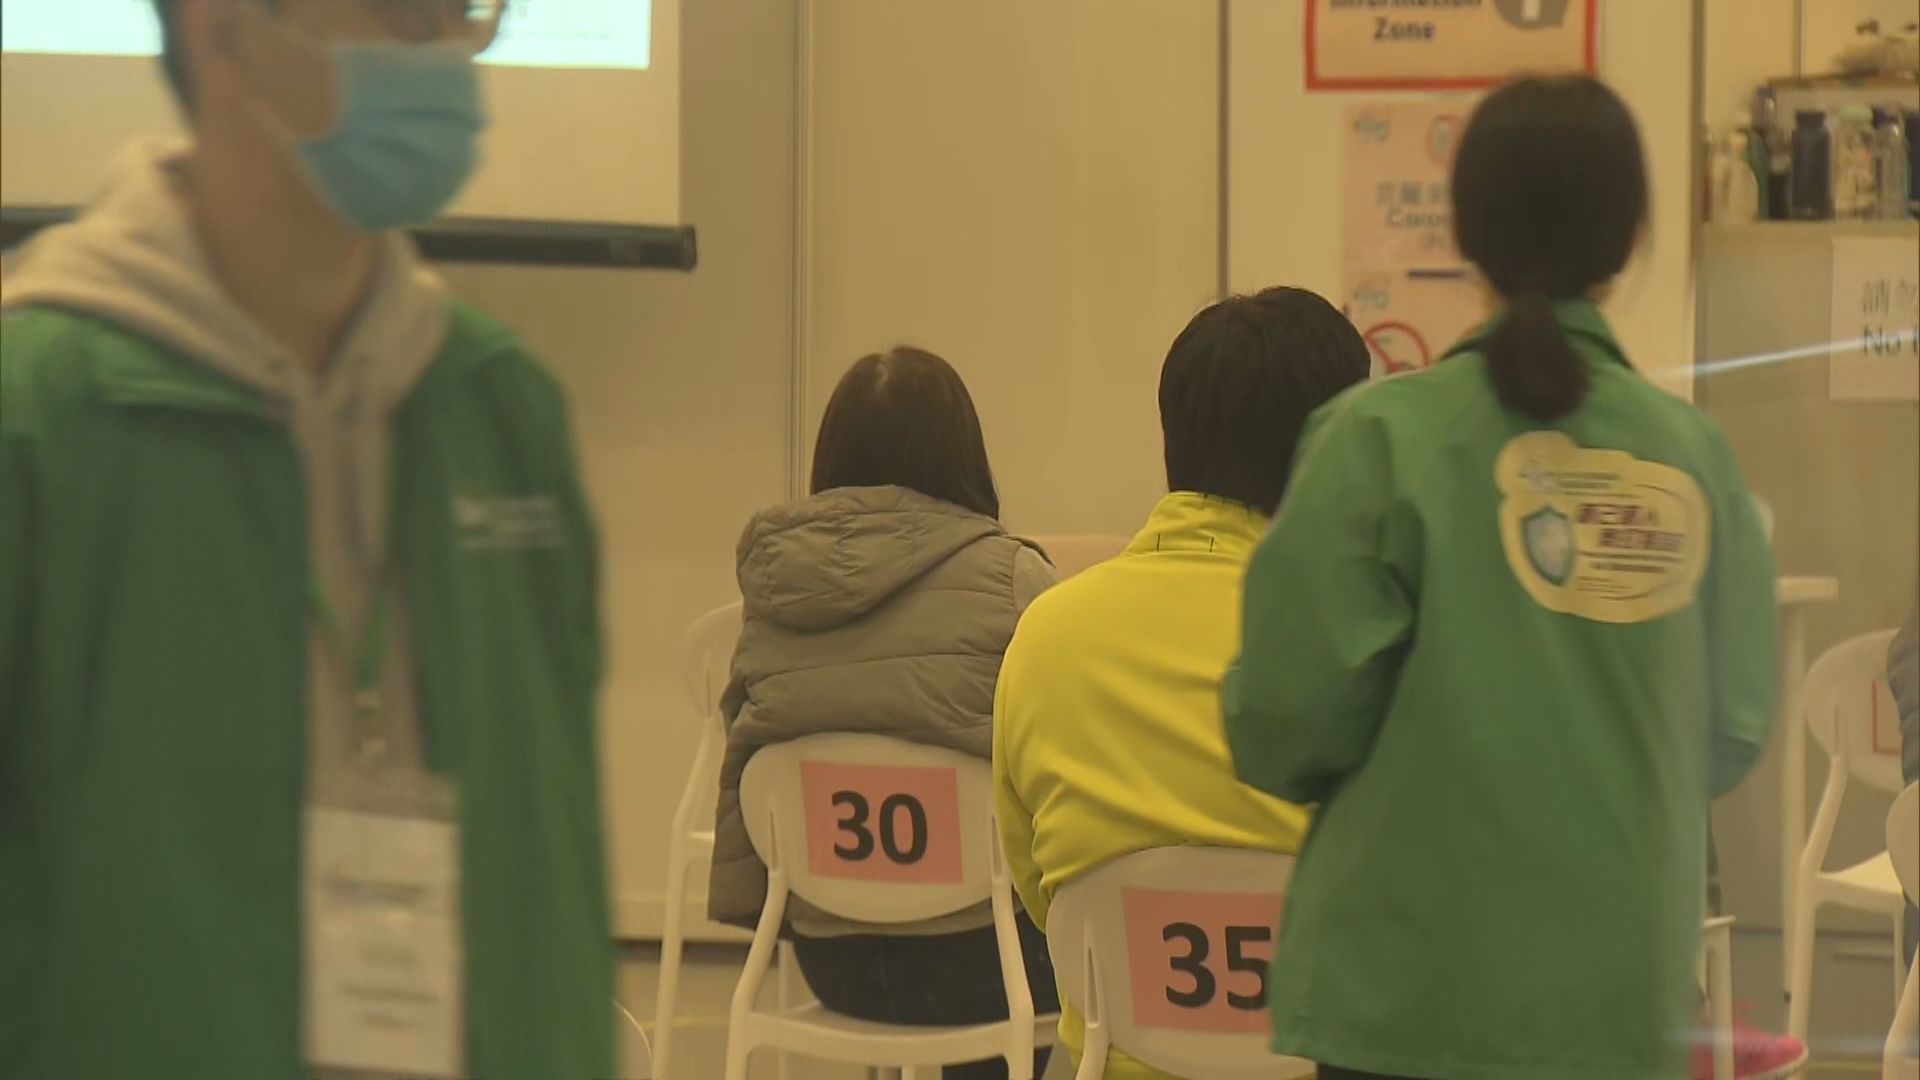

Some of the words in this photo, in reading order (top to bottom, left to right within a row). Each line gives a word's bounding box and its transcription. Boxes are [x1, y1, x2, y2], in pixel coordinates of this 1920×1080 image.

[1374, 17, 1436, 41] Zone
[831, 790, 928, 865] 30
[1162, 922, 1271, 1011] 35
